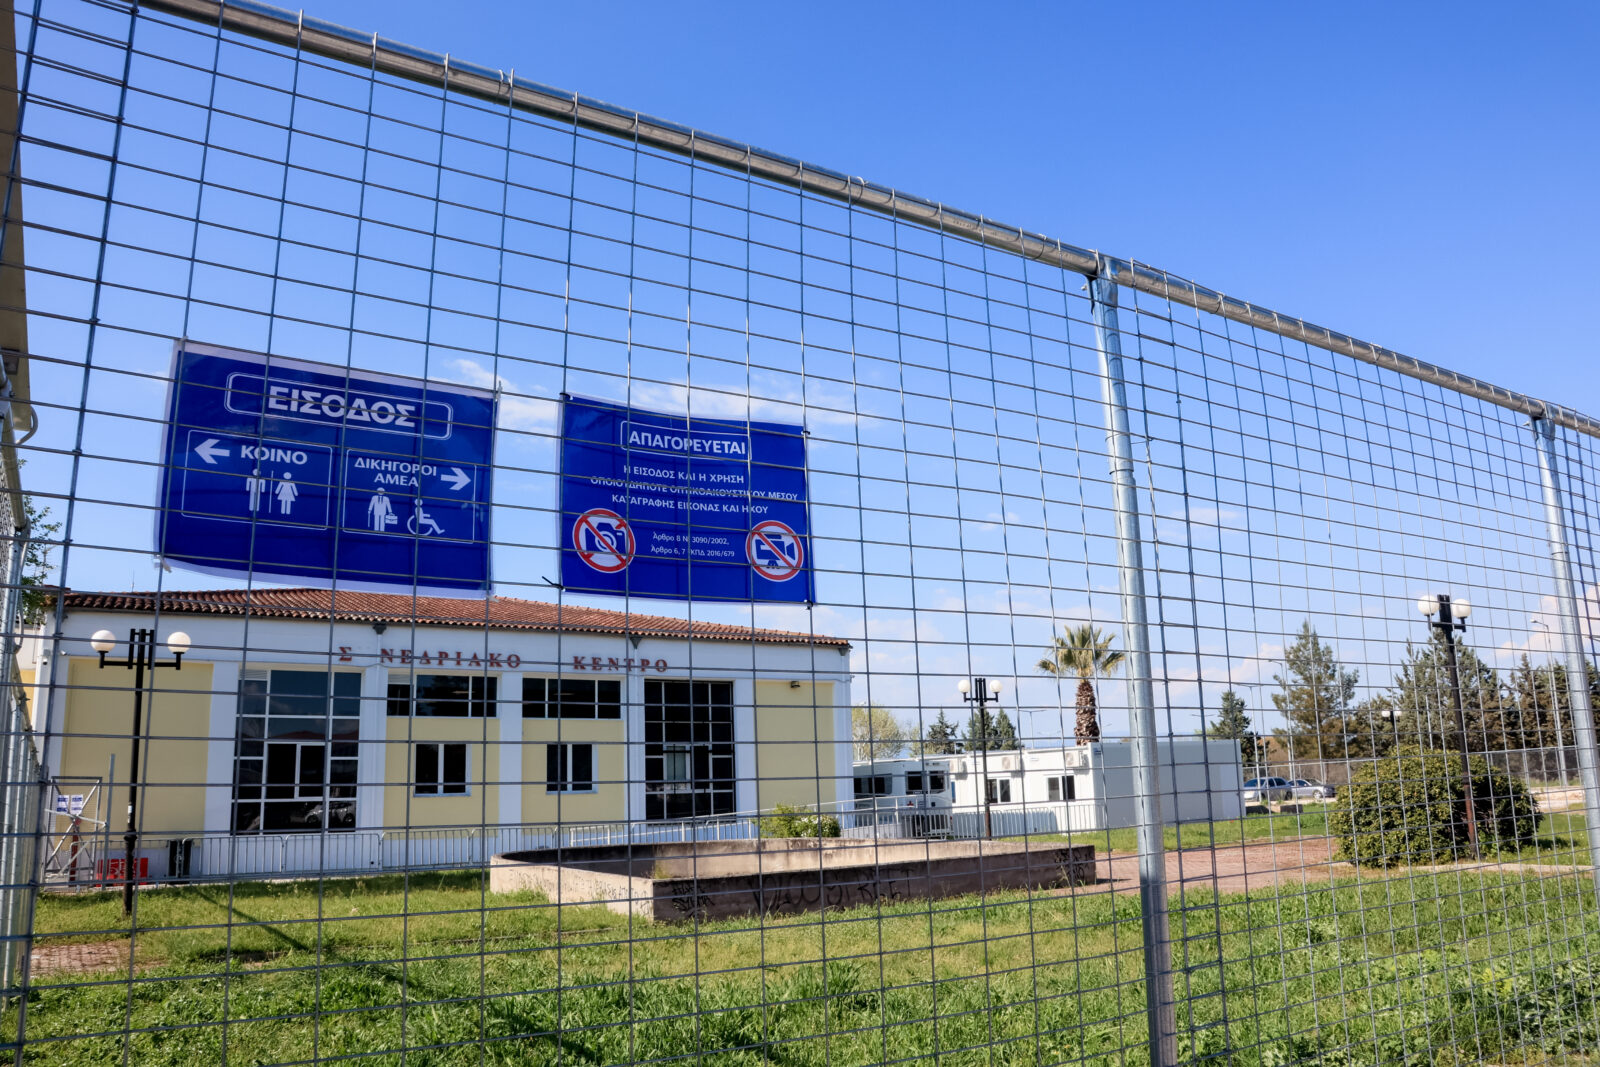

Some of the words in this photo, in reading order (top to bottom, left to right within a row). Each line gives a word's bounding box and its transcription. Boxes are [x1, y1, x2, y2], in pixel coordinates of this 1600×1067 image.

[268, 385, 416, 428] ΕΙΣΟΔΟΣ
[629, 430, 746, 455] ΑΠΑΓΟΡΕΥΕΤΑΙ
[240, 444, 308, 466] ΚΟΙΝΟ
[354, 457, 437, 477] ΔΙΚΗΓΟΡΟΙ
[623, 465, 631, 474] Η
[633, 466, 676, 479] ΕΙΣΟΔΟΣ
[678, 471, 696, 481] ΚΑΙ
[698, 473, 707, 482] Η
[709, 474, 745, 484] ΧΡΗΣΗ
[374, 473, 419, 487] ΑΜΕΑ
[677, 501, 720, 512] ΕΙΚΟΝΑΣ
[722, 504, 740, 513] ΚΑΙ
[741, 504, 769, 514] ΗΧΟΥ
[688, 548, 706, 556] ΚΠΔ
[573, 655, 668, 673] ΚΕΝΤΡΟ
